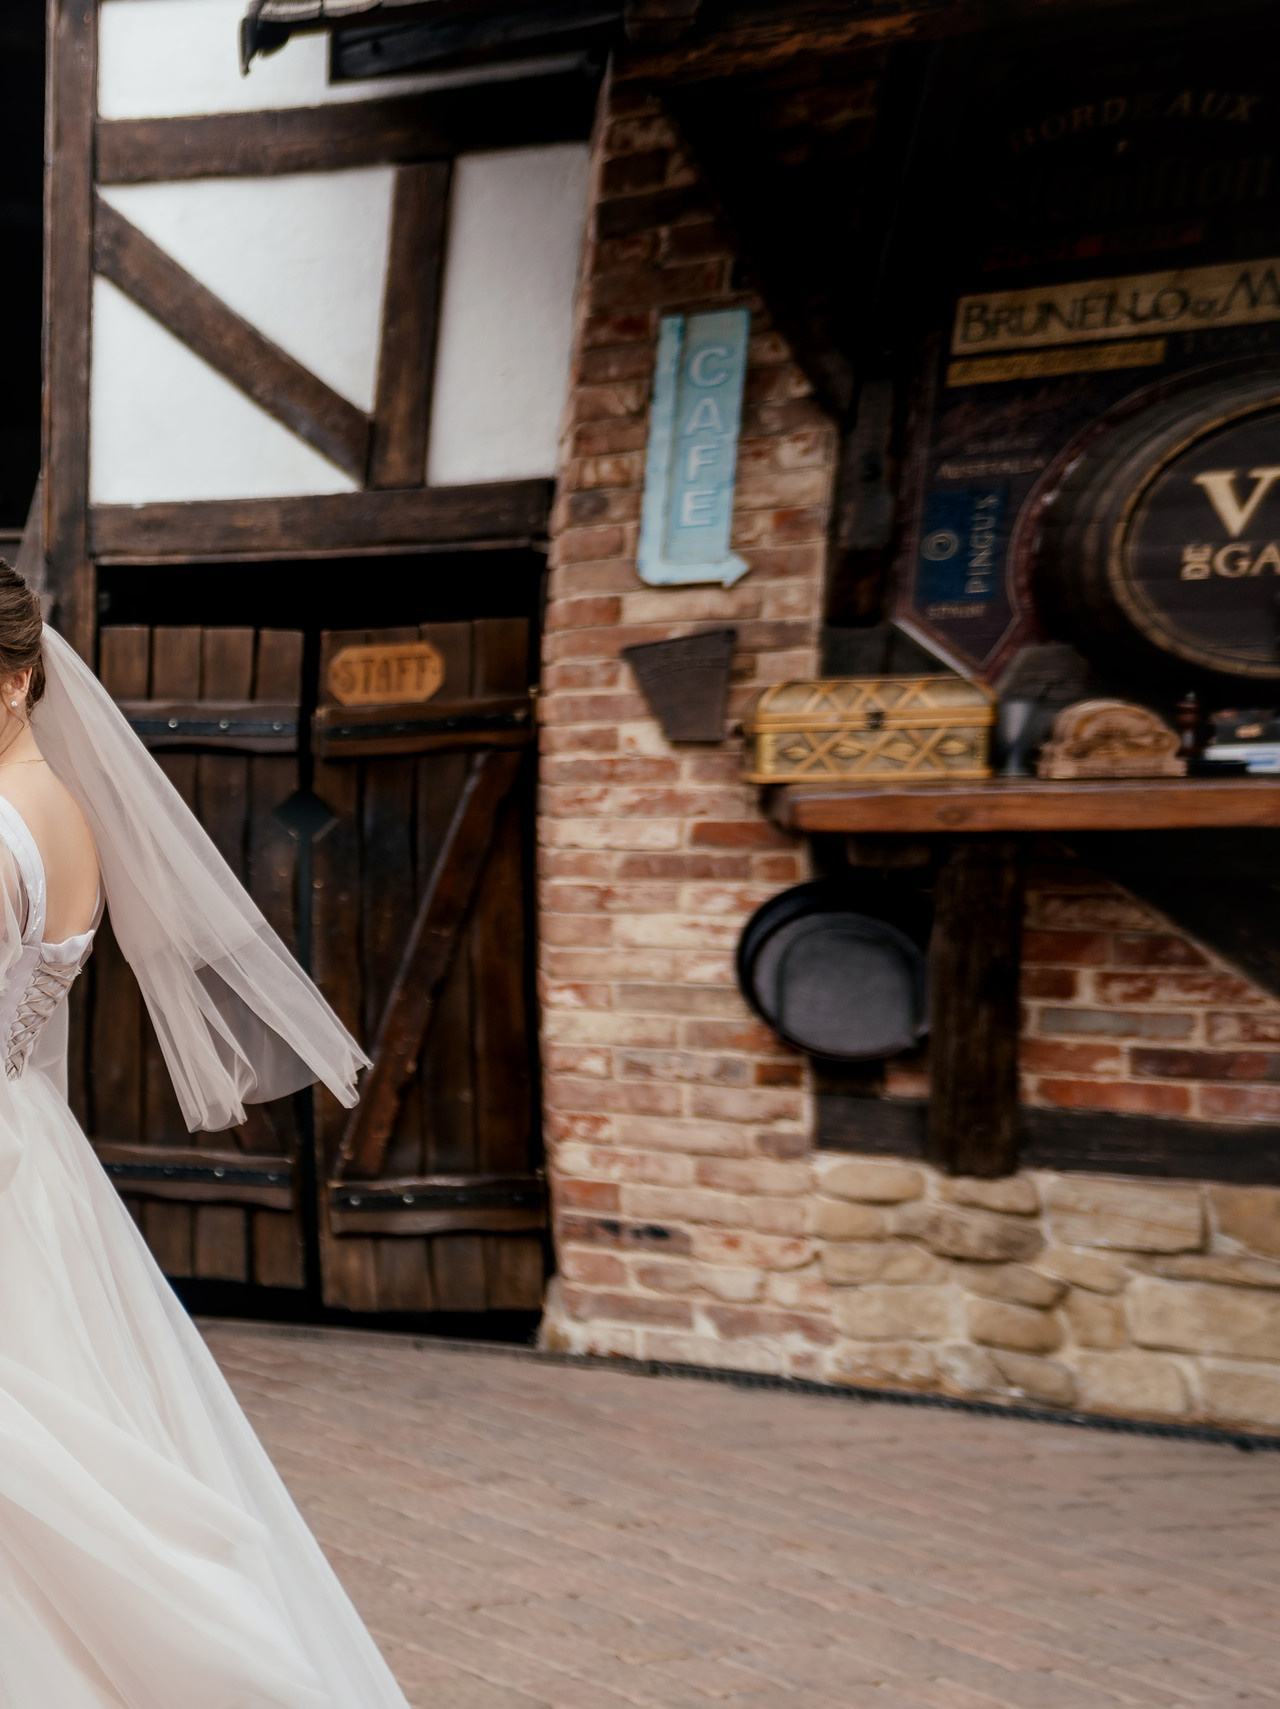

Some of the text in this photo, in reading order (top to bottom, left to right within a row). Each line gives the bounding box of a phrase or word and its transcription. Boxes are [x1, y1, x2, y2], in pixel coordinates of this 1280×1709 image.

[679, 346, 732, 527] CAFE
[964, 494, 999, 594] PINGUS
[336, 655, 431, 694] STAFF
